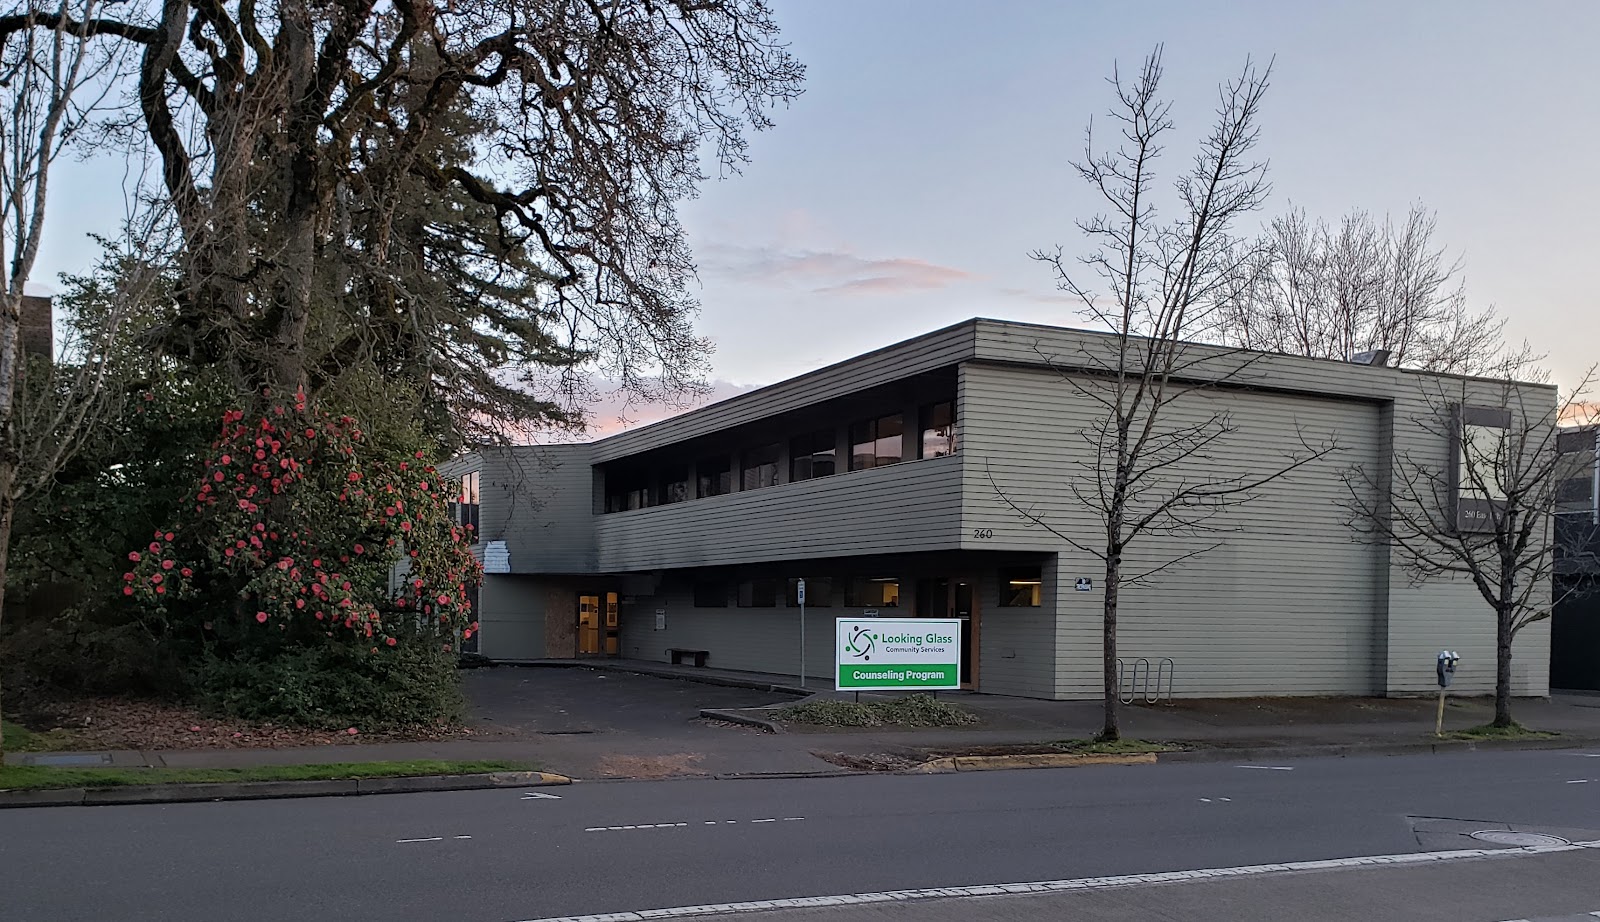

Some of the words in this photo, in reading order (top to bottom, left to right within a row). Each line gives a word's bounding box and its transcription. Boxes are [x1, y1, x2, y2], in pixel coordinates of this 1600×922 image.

[974, 529, 993, 539] 260
[882, 633, 922, 646] Looking
[926, 633, 953, 644] Glass
[885, 646, 920, 654] Community
[853, 670, 905, 681] Counseling
[906, 670, 945, 681] Program
